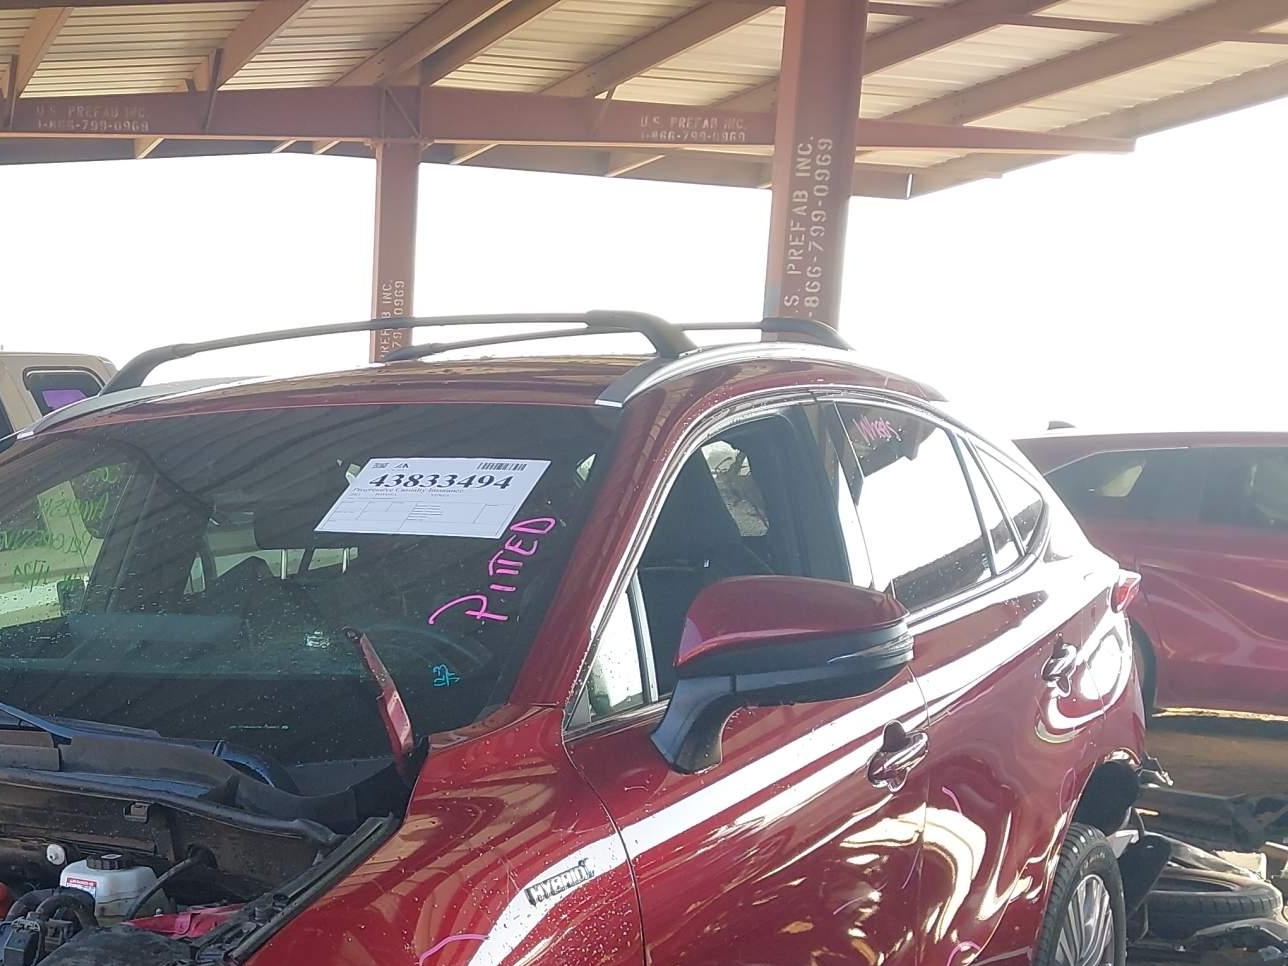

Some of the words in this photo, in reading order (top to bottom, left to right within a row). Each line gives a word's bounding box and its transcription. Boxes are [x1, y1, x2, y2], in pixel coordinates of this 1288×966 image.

[795, 136, 815, 177] INC.
[786, 190, 809, 275] PREFAB
[803, 137, 834, 317] -866-799-0969
[369, 473, 514, 489] 43833494
